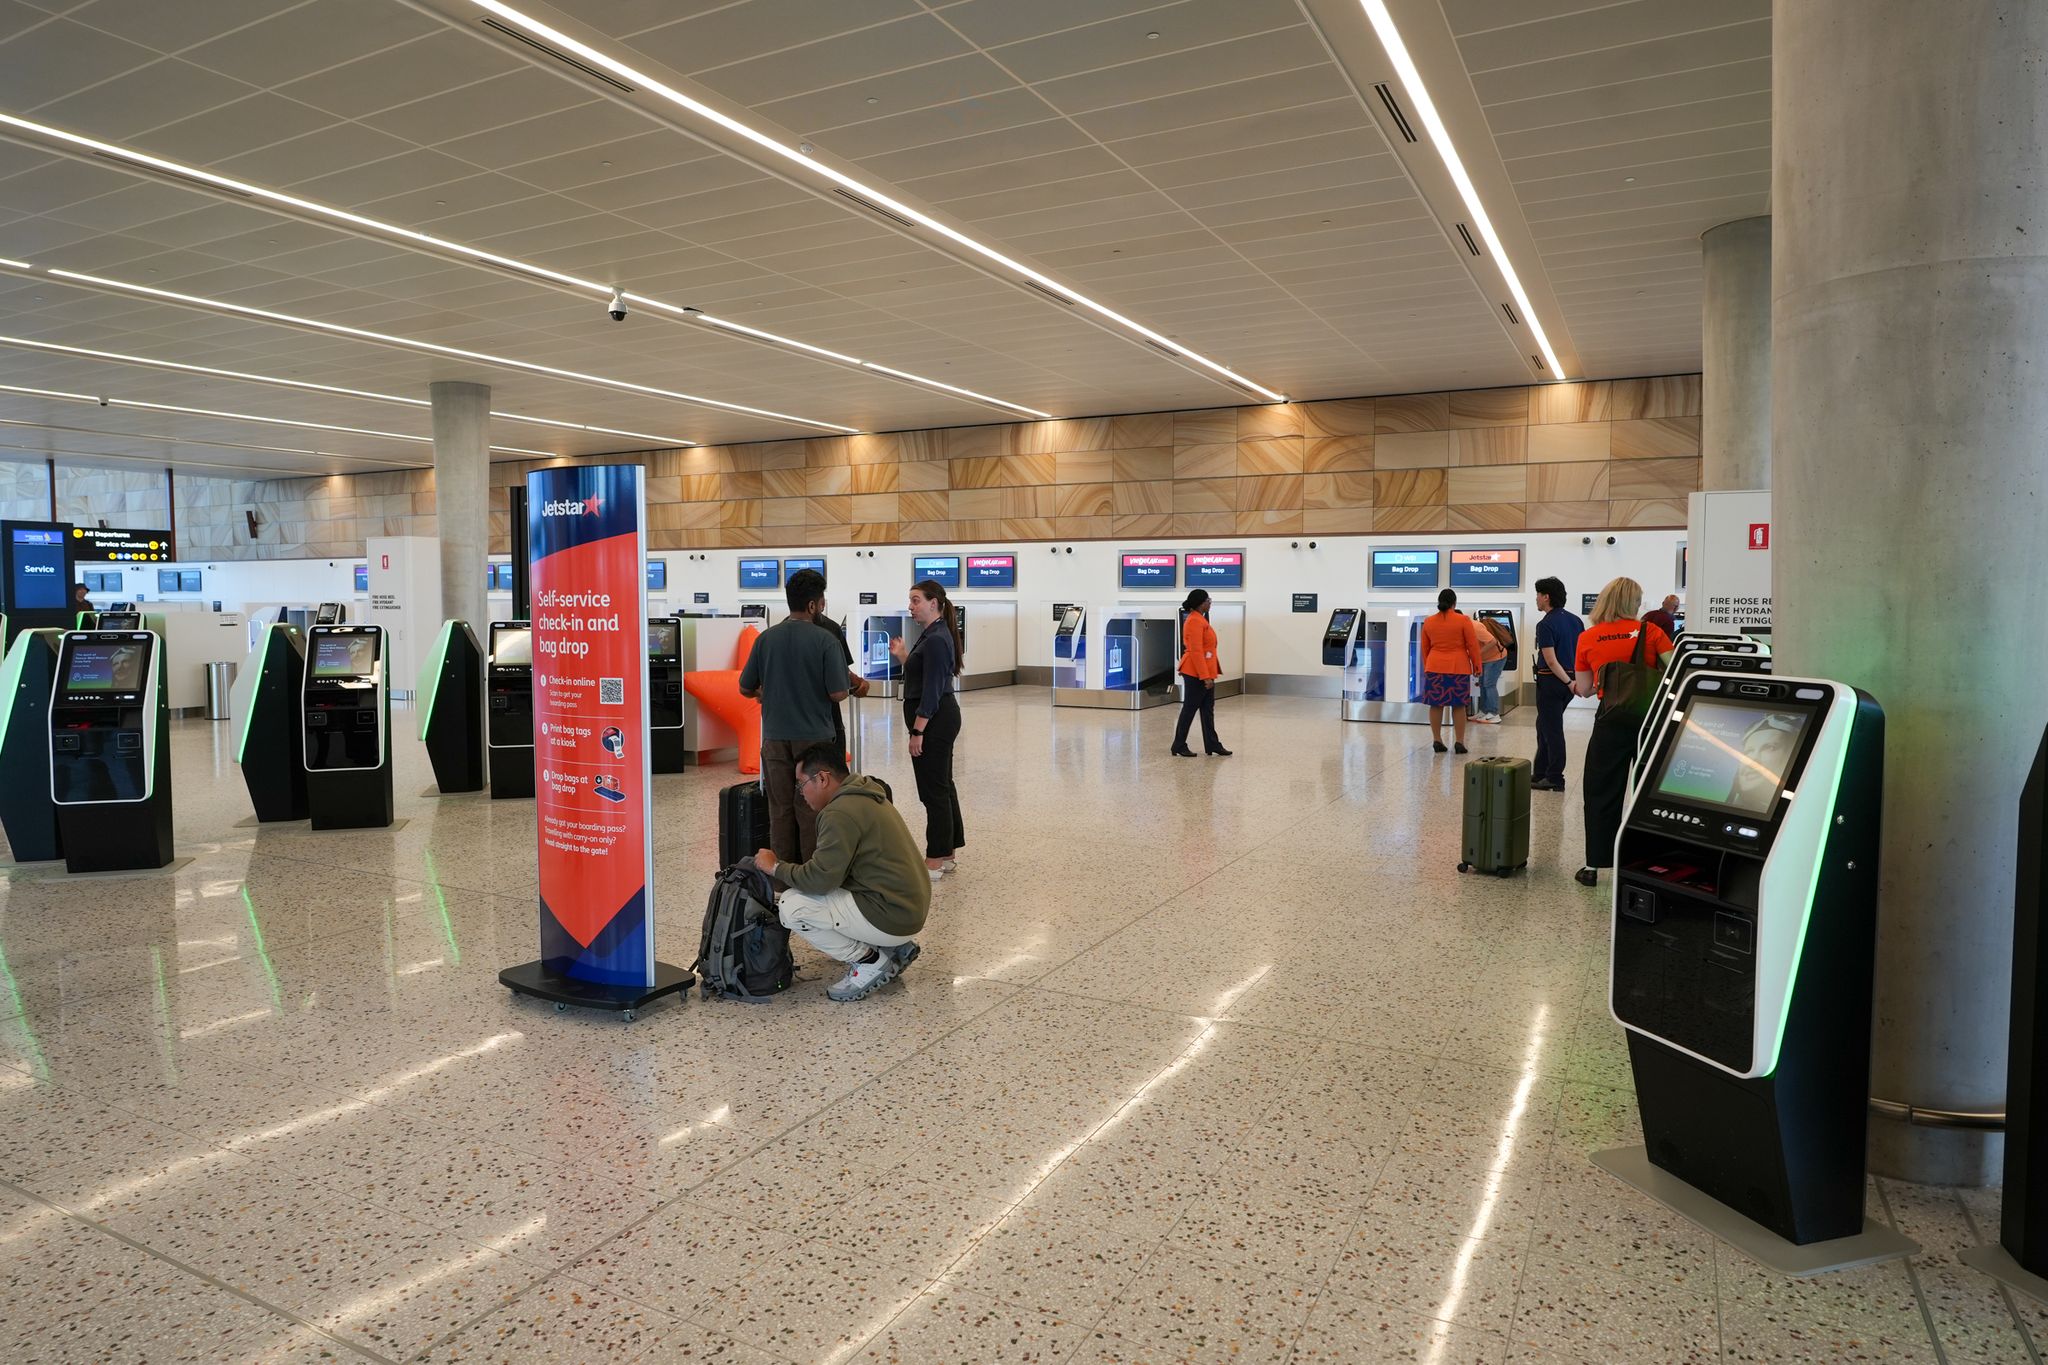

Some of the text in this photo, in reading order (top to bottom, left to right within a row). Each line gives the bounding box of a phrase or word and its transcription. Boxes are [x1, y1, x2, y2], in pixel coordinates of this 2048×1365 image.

[542, 499, 584, 517] Jetstar
[95, 531, 130, 539] Departures
[24, 565, 55, 573] Service
[1470, 565, 1499, 573] Bag Drop
[538, 590, 611, 608] Self-service
[1709, 597, 1772, 605] FIRE HOSE RE
[1733, 607, 1772, 615] HYDRAN
[538, 613, 619, 631] check-in and
[1709, 616, 1772, 625] FIRE EXTINGU
[1597, 633, 1631, 642] Jetstar
[539, 637, 589, 659] bag drop
[549, 675, 572, 686] Check-in
[573, 677, 596, 687] online
[563, 691, 571, 699] get
[571, 692, 582, 700] your
[550, 723, 563, 734] Print
[563, 724, 575, 736] bag
[575, 726, 592, 738] tags
[561, 738, 576, 748] kiosk
[551, 770, 564, 781] Drop
[564, 772, 580, 784] bags
[580, 775, 589, 784] at
[551, 781, 576, 796] bag drop
[558, 819, 567, 827] got
[567, 821, 578, 829] your
[578, 822, 606, 834] boarding
[606, 824, 627, 833] pass?
[563, 831, 573, 840] with
[573, 834, 598, 843] carry-on
[598, 836, 617, 846] only?
[555, 841, 573, 852] straight
[573, 844, 580, 852] to
[579, 845, 590, 853] the
[590, 847, 609, 856] gate!
